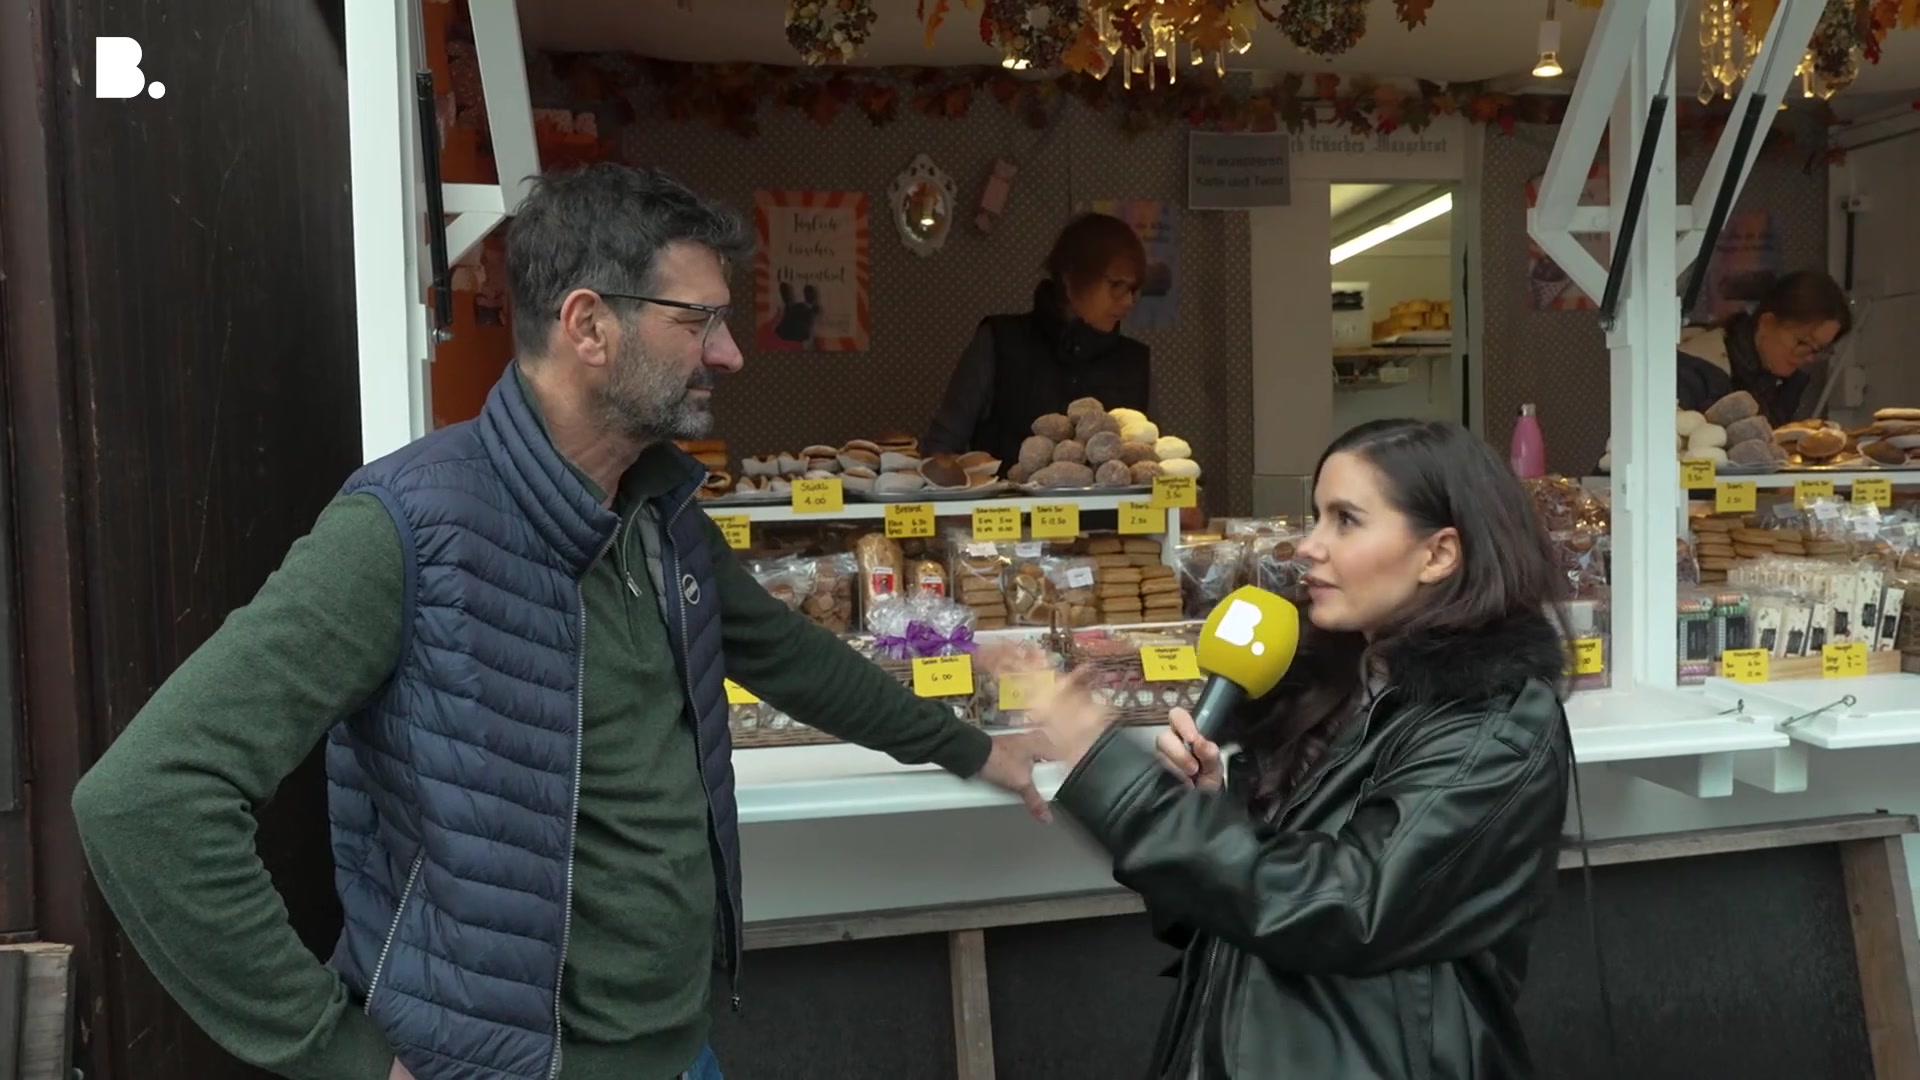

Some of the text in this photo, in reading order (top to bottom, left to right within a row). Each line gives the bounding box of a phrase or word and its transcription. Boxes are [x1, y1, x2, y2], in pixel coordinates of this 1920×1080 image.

[804, 496, 827, 505] 4.00
[1214, 598, 1265, 656] B.
[931, 673, 953, 682] 6.00
